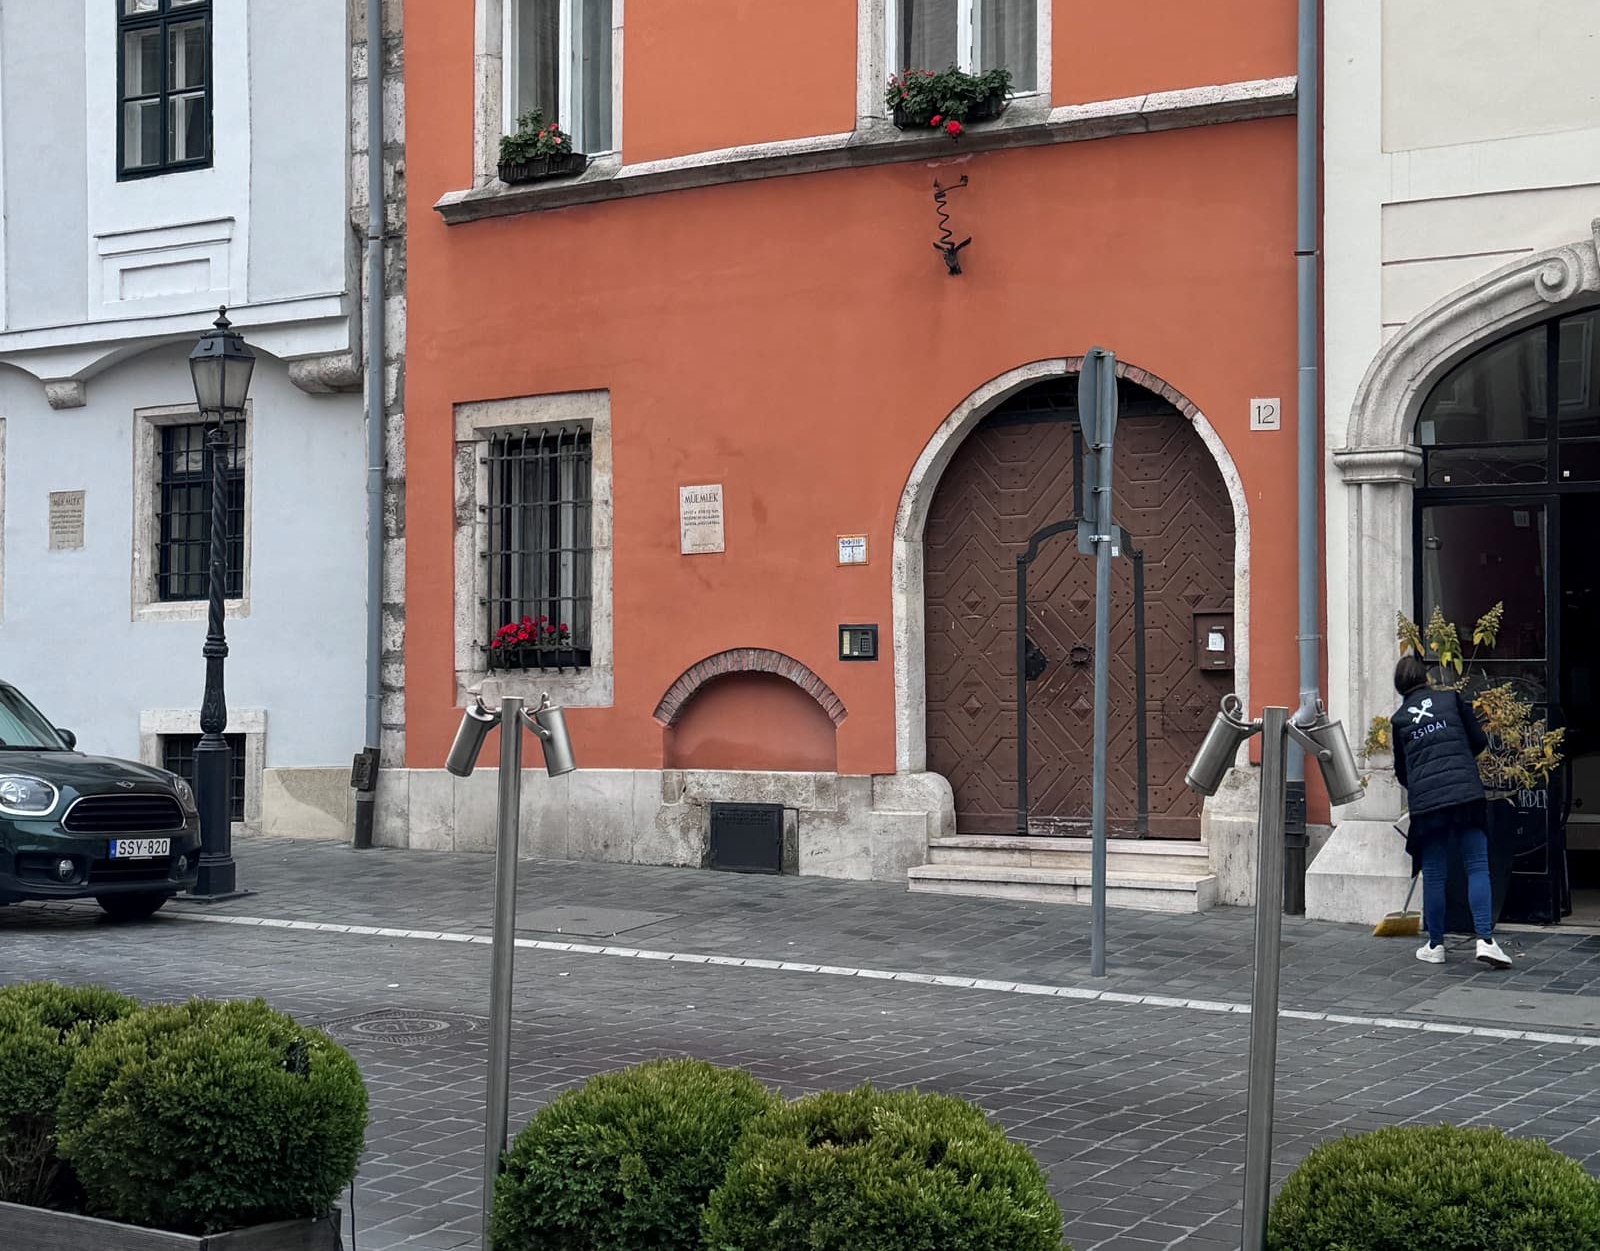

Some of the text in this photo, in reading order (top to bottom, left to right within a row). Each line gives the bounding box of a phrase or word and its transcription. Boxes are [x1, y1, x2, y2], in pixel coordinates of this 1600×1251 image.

[1256, 404, 1275, 424] 12
[1411, 720, 1447, 739] ZSIDAI
[119, 840, 168, 855] SSY-820
